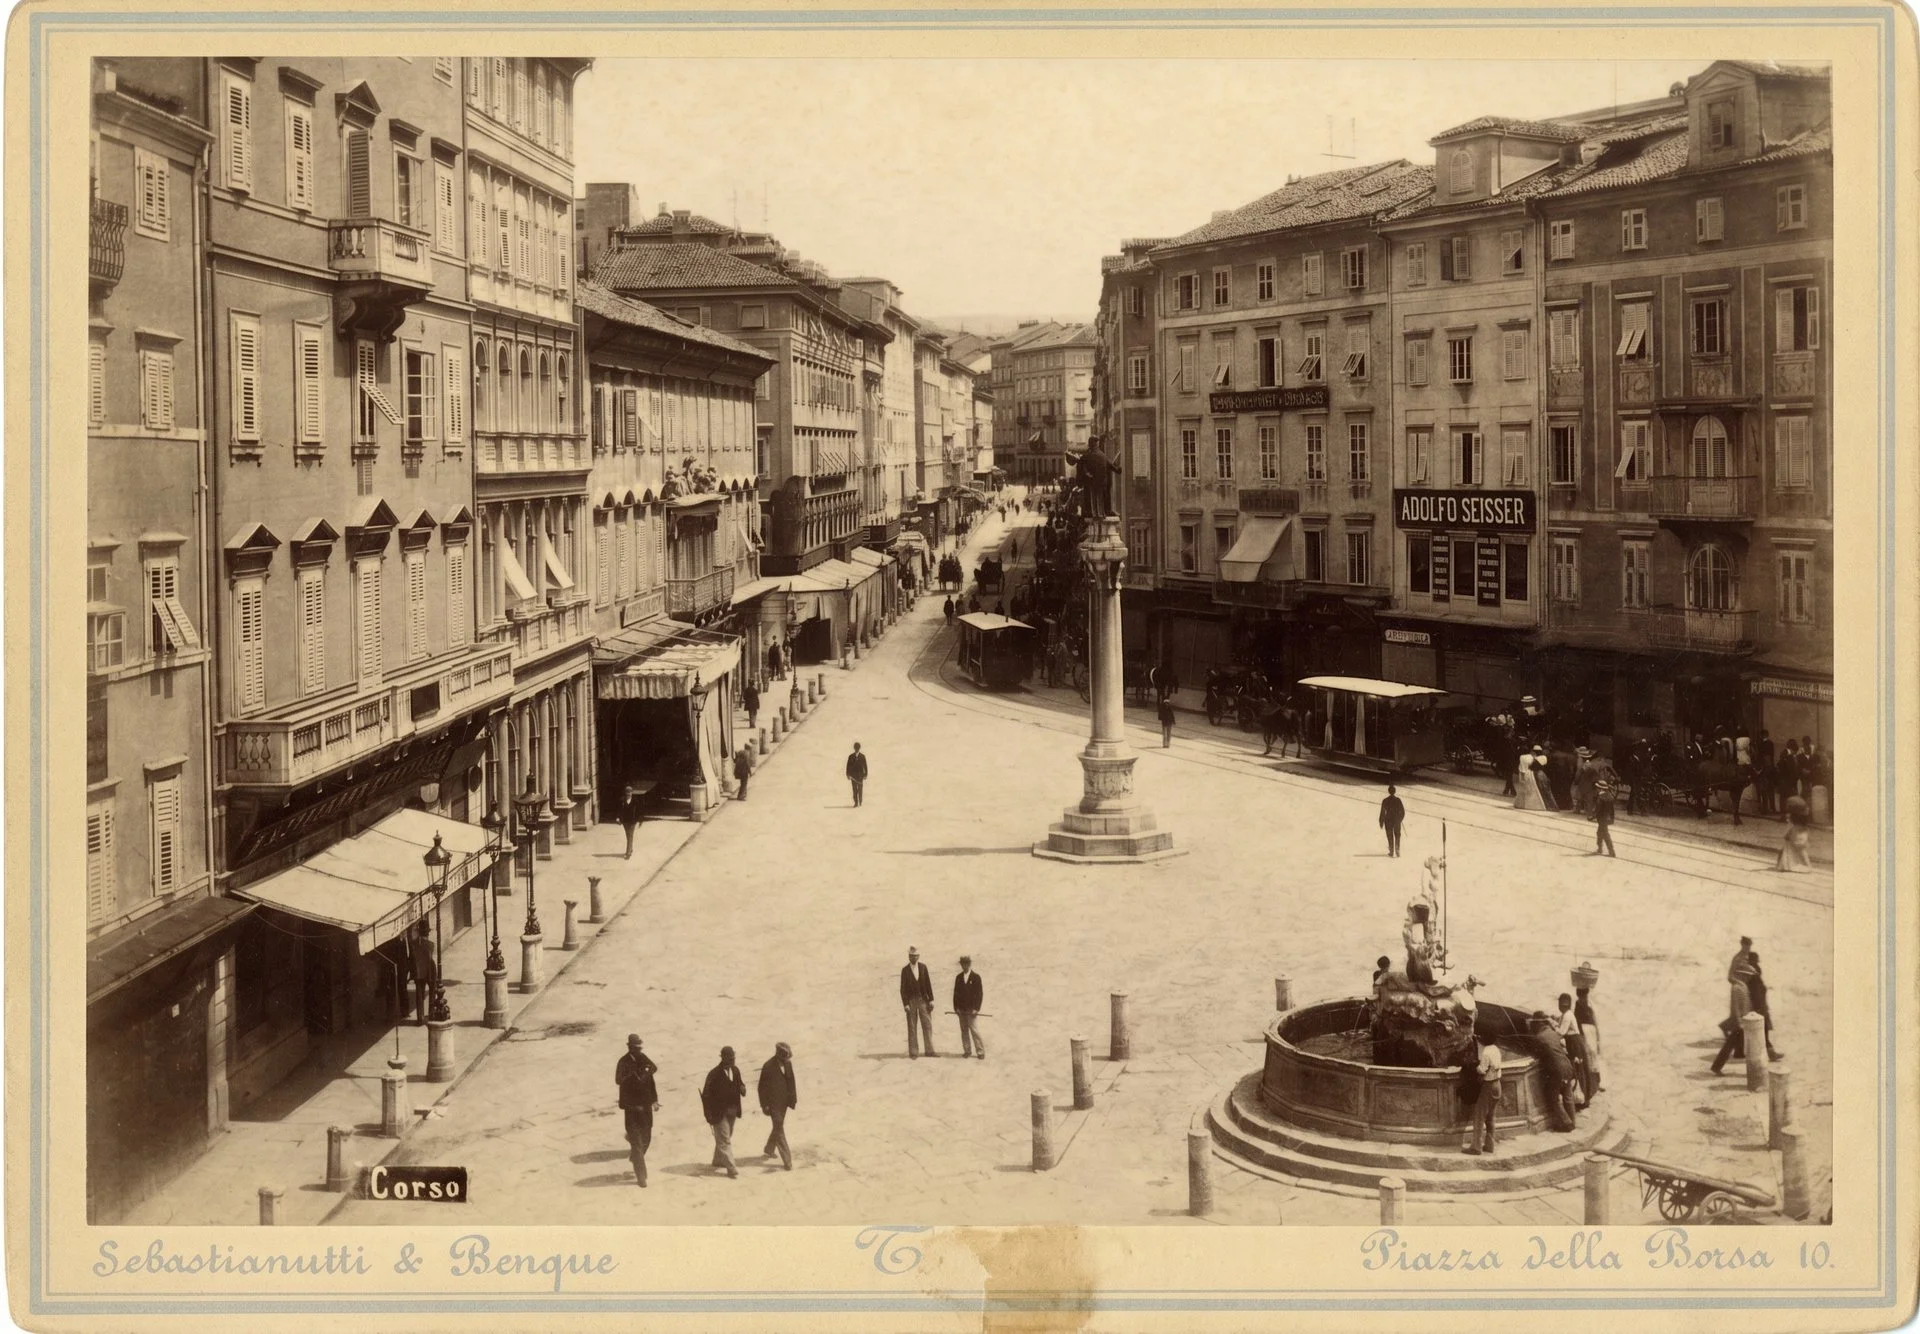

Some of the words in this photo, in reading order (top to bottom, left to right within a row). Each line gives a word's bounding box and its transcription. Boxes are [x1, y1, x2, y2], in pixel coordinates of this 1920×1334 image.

[1402, 496, 1457, 522] ADOLFO
[1461, 497, 1525, 525] SEISSER
[92, 1238, 372, 1278] Sebastianutti
[394, 1242, 423, 1276] &
[449, 1234, 619, 1292] Benque
[1361, 1228, 1503, 1271] Piazza
[1521, 1231, 1623, 1271] della
[1645, 1227, 1775, 1271] Borsa
[1800, 1240, 1835, 1269] 10.
